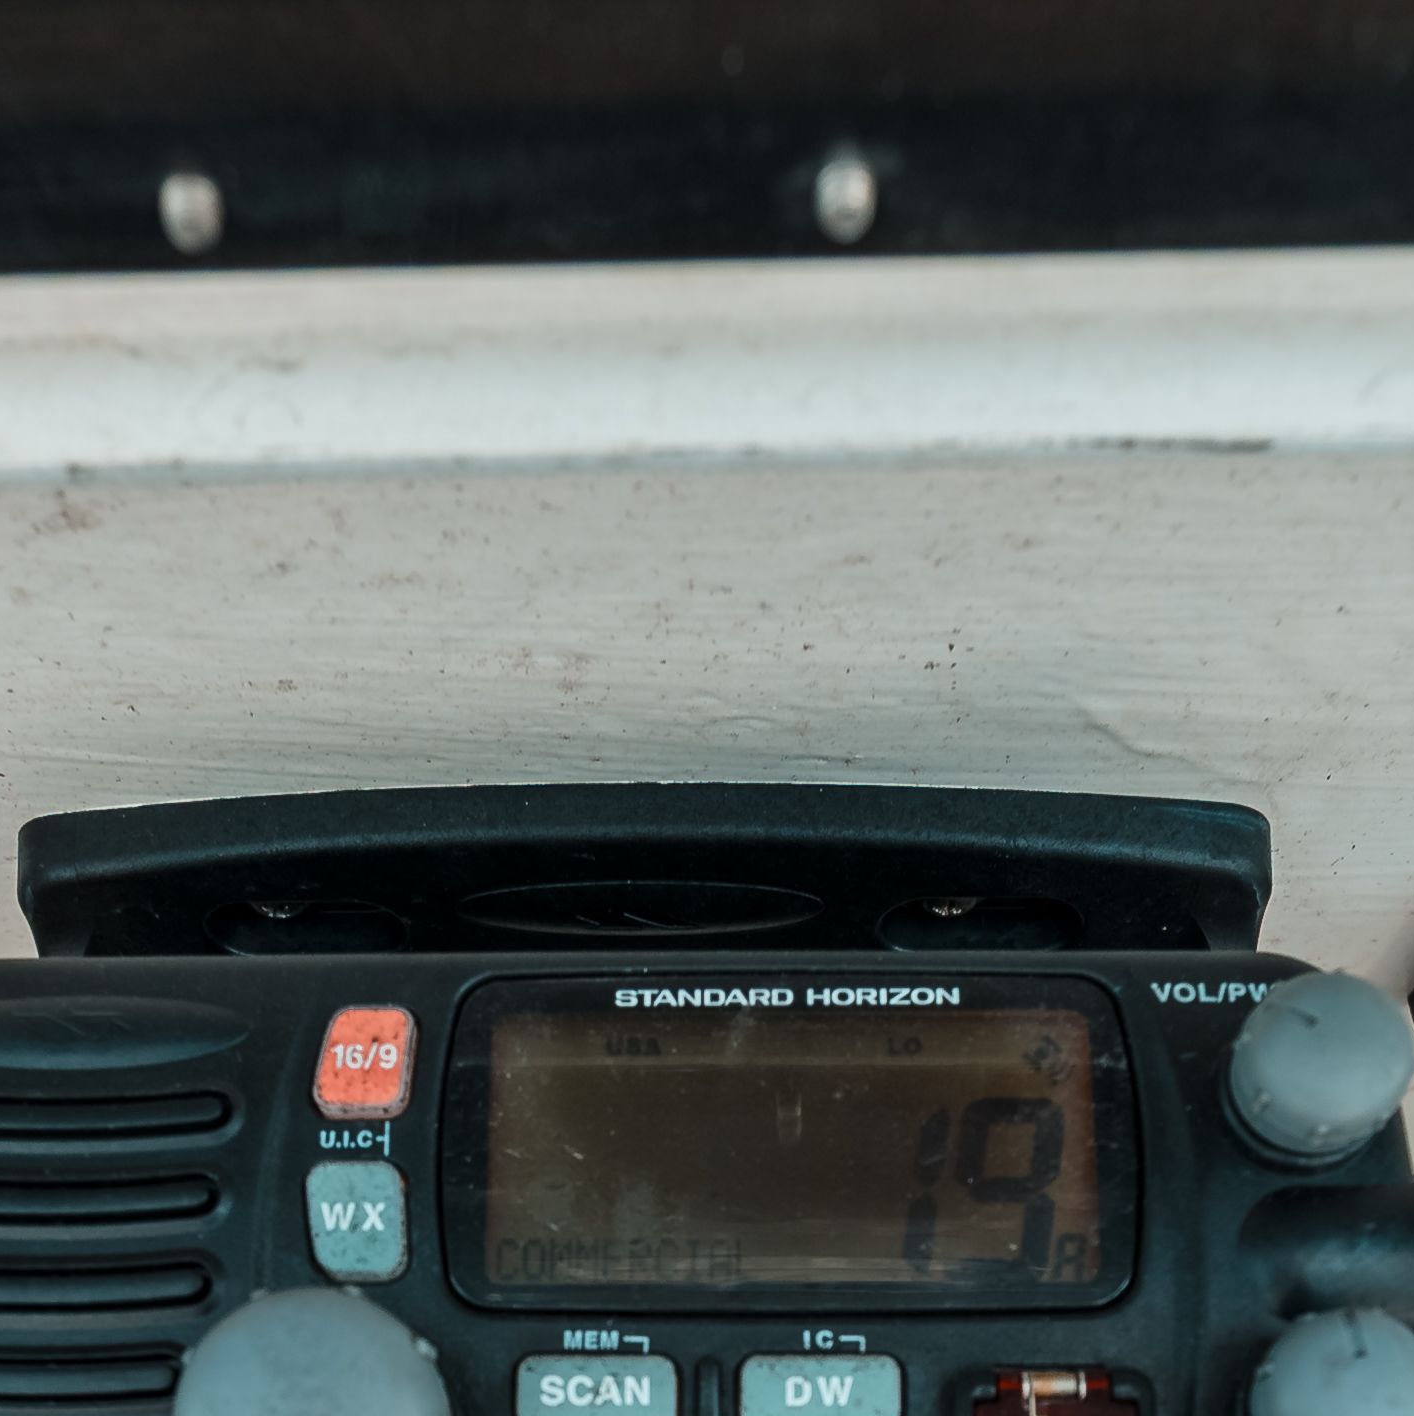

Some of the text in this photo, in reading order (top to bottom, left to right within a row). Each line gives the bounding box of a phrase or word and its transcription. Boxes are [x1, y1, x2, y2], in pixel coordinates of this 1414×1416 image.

[615, 987, 960, 1007] STANDARD HORIZON
[330, 1042, 399, 1070] 16/9
[887, 1037, 923, 1056] LO
[320, 1201, 386, 1232] WX
[563, 1330, 620, 1350] MEM
[539, 1375, 652, 1407] SCAN
[785, 1375, 854, 1407] DW
